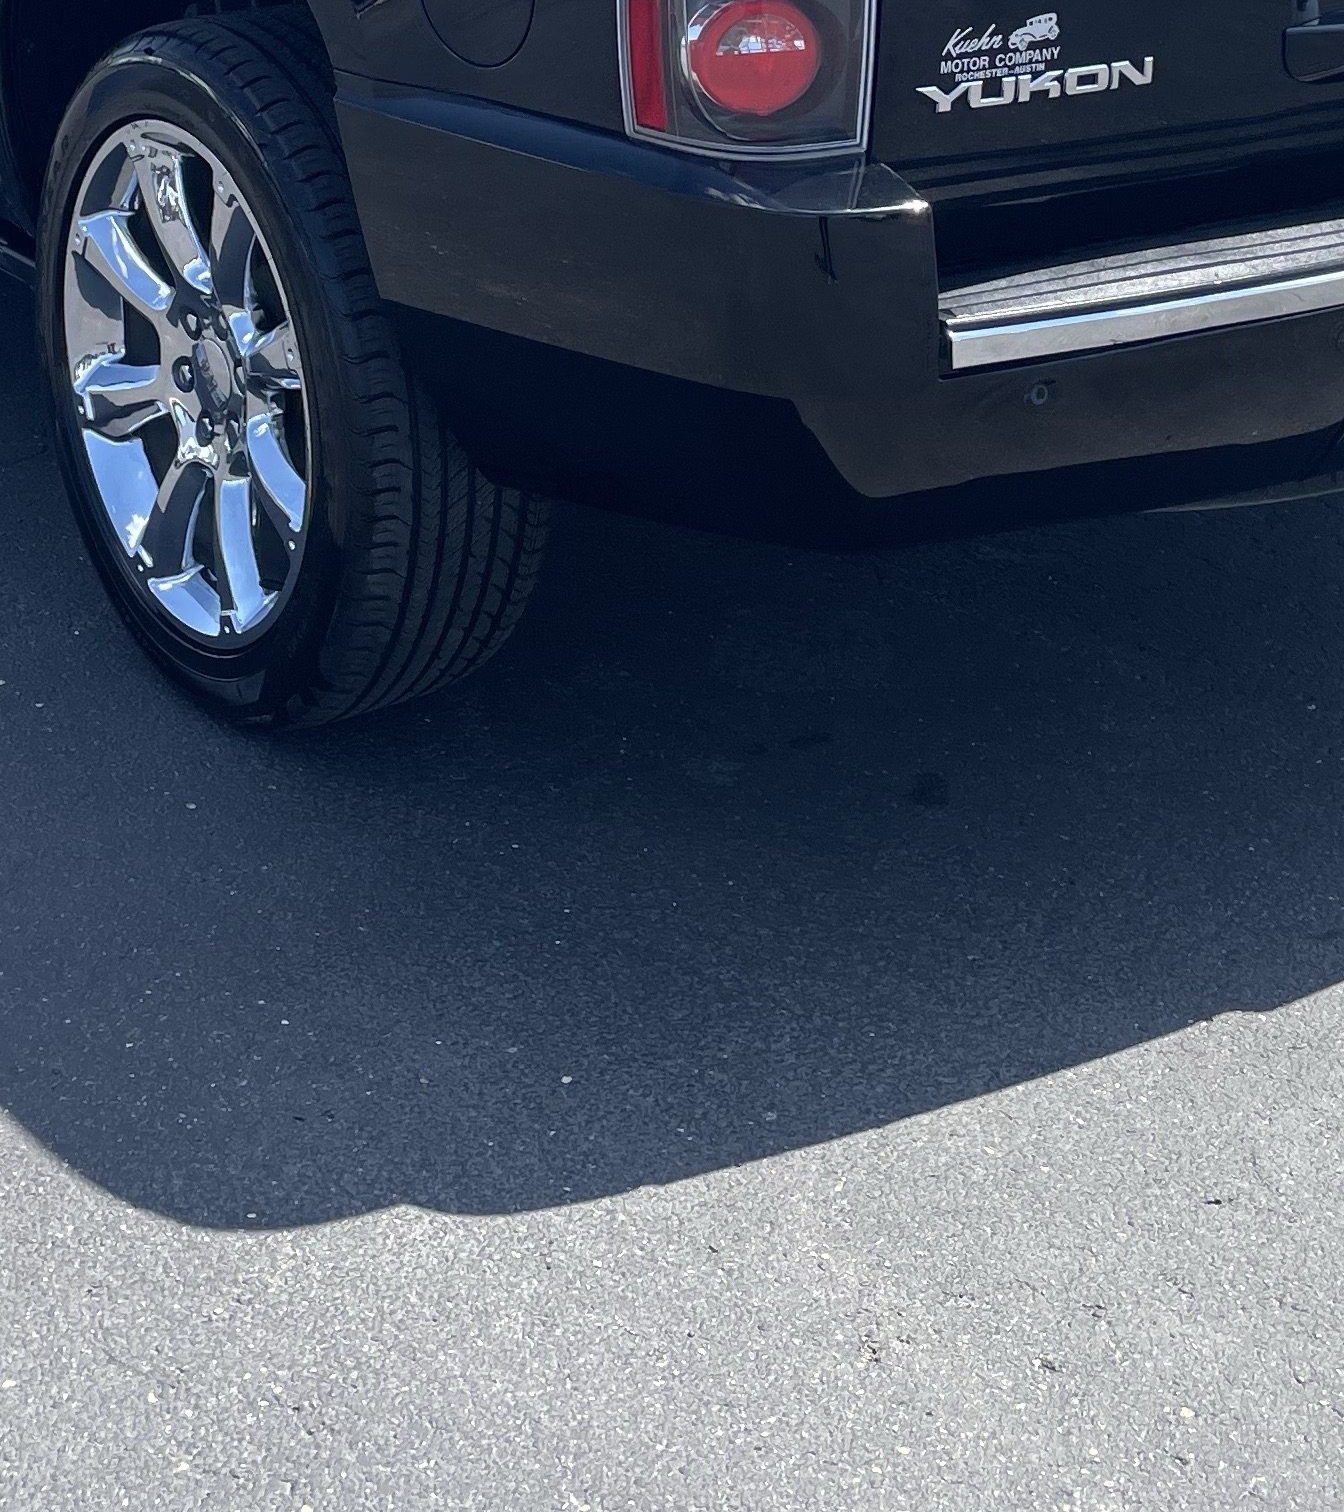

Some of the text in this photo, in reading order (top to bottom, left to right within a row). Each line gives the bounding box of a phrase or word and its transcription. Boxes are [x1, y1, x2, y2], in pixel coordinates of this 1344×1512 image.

[941, 23, 1003, 57] Kuehn
[940, 46, 1061, 74] MOTOR COMPANY
[915, 56, 1154, 113] YUKON
